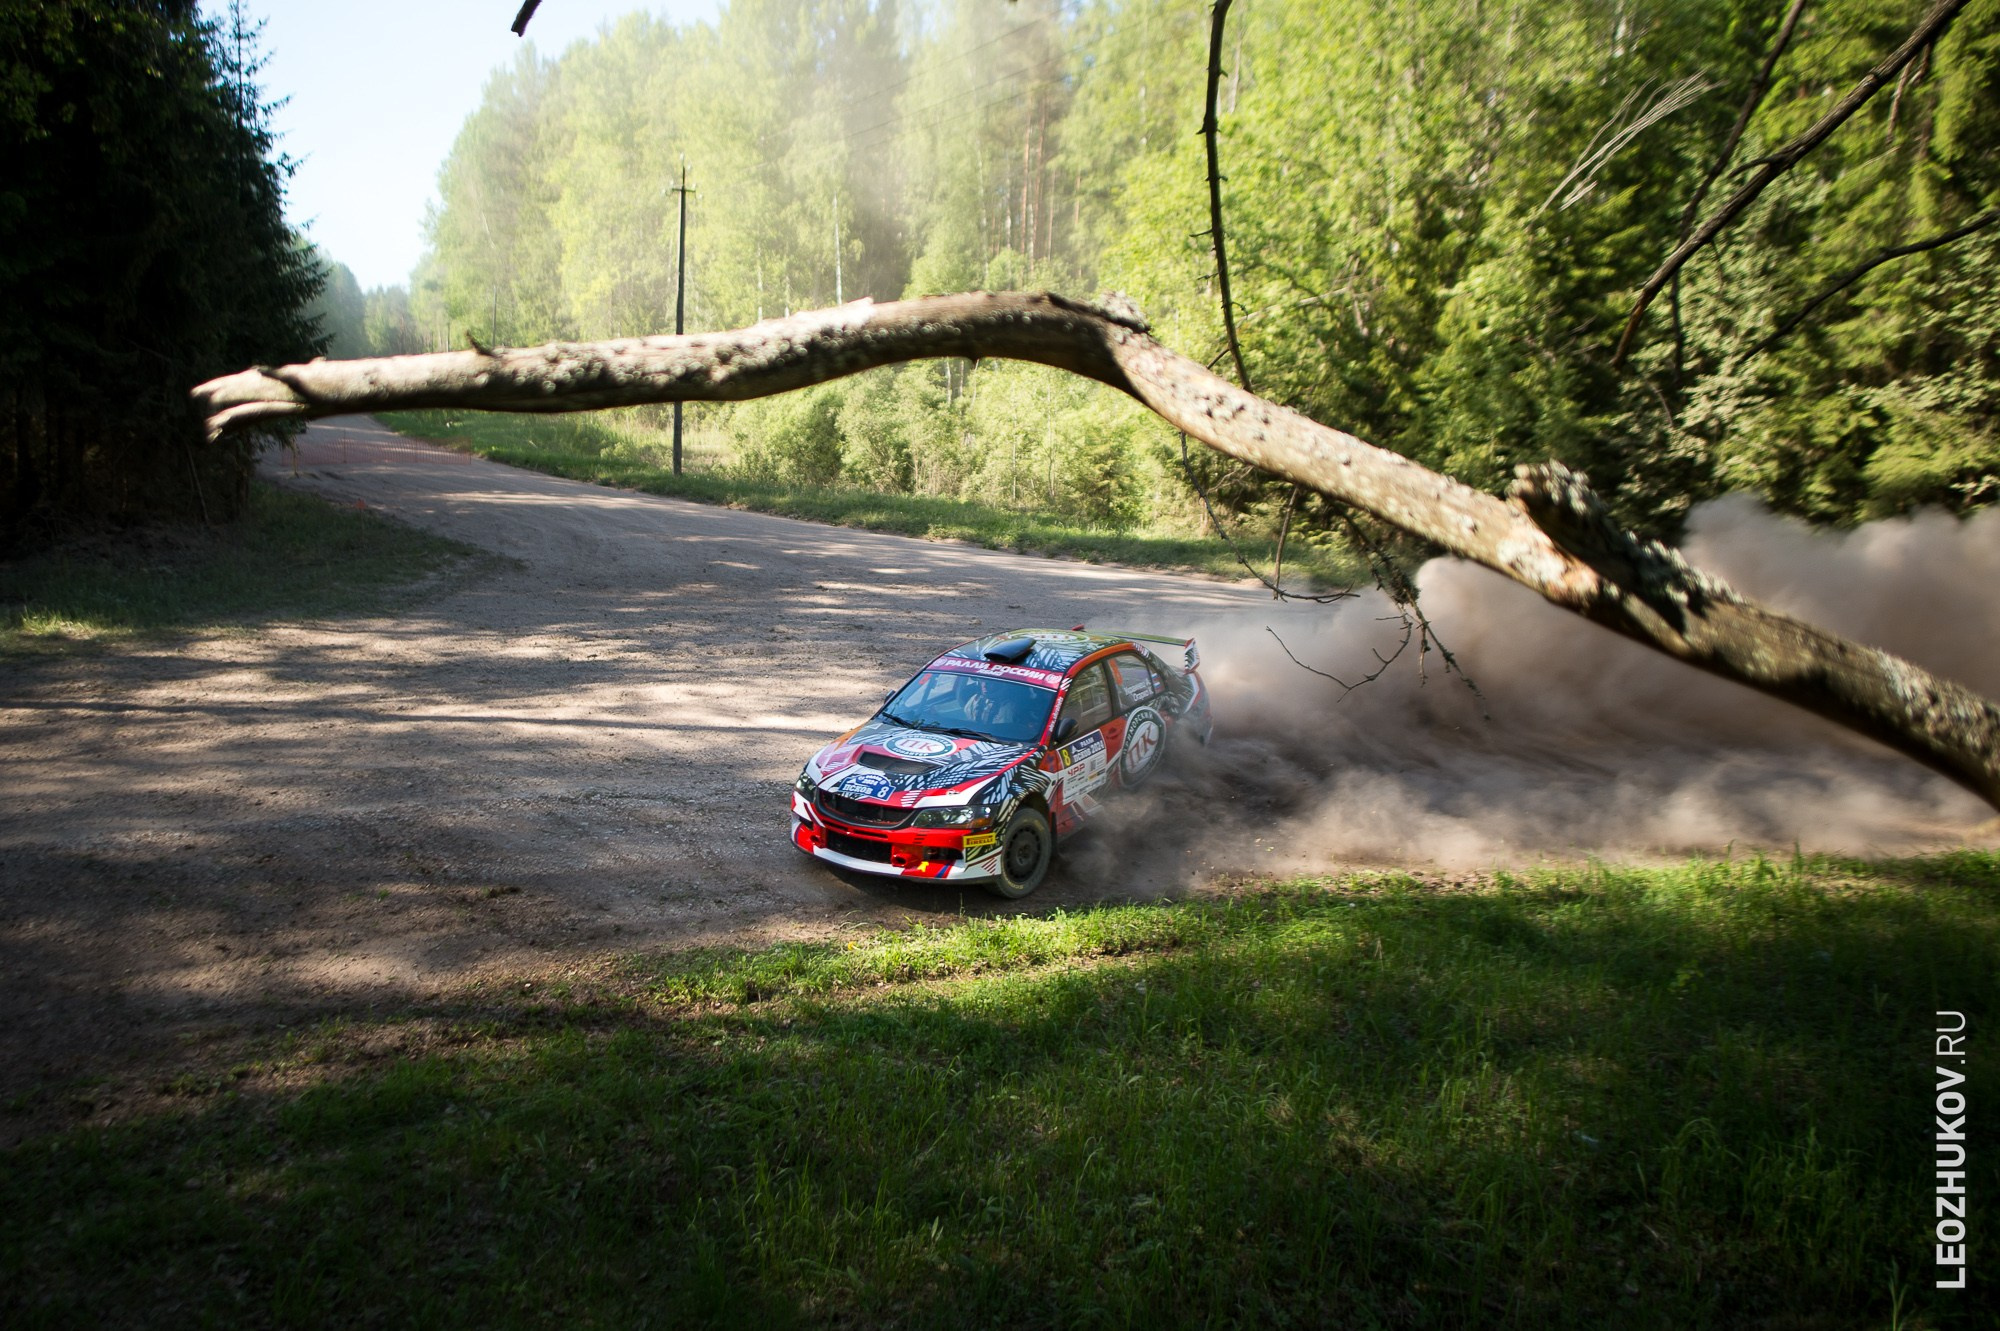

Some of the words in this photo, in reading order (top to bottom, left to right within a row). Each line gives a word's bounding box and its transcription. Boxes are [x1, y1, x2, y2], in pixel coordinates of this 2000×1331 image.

[945, 659, 990, 670] РАЛЛИ
[991, 664, 1046, 680] РОССИИ
[1062, 749, 1071, 766] 8
[842, 784, 874, 795] ПСКОВ
[877, 786, 890, 798] 8
